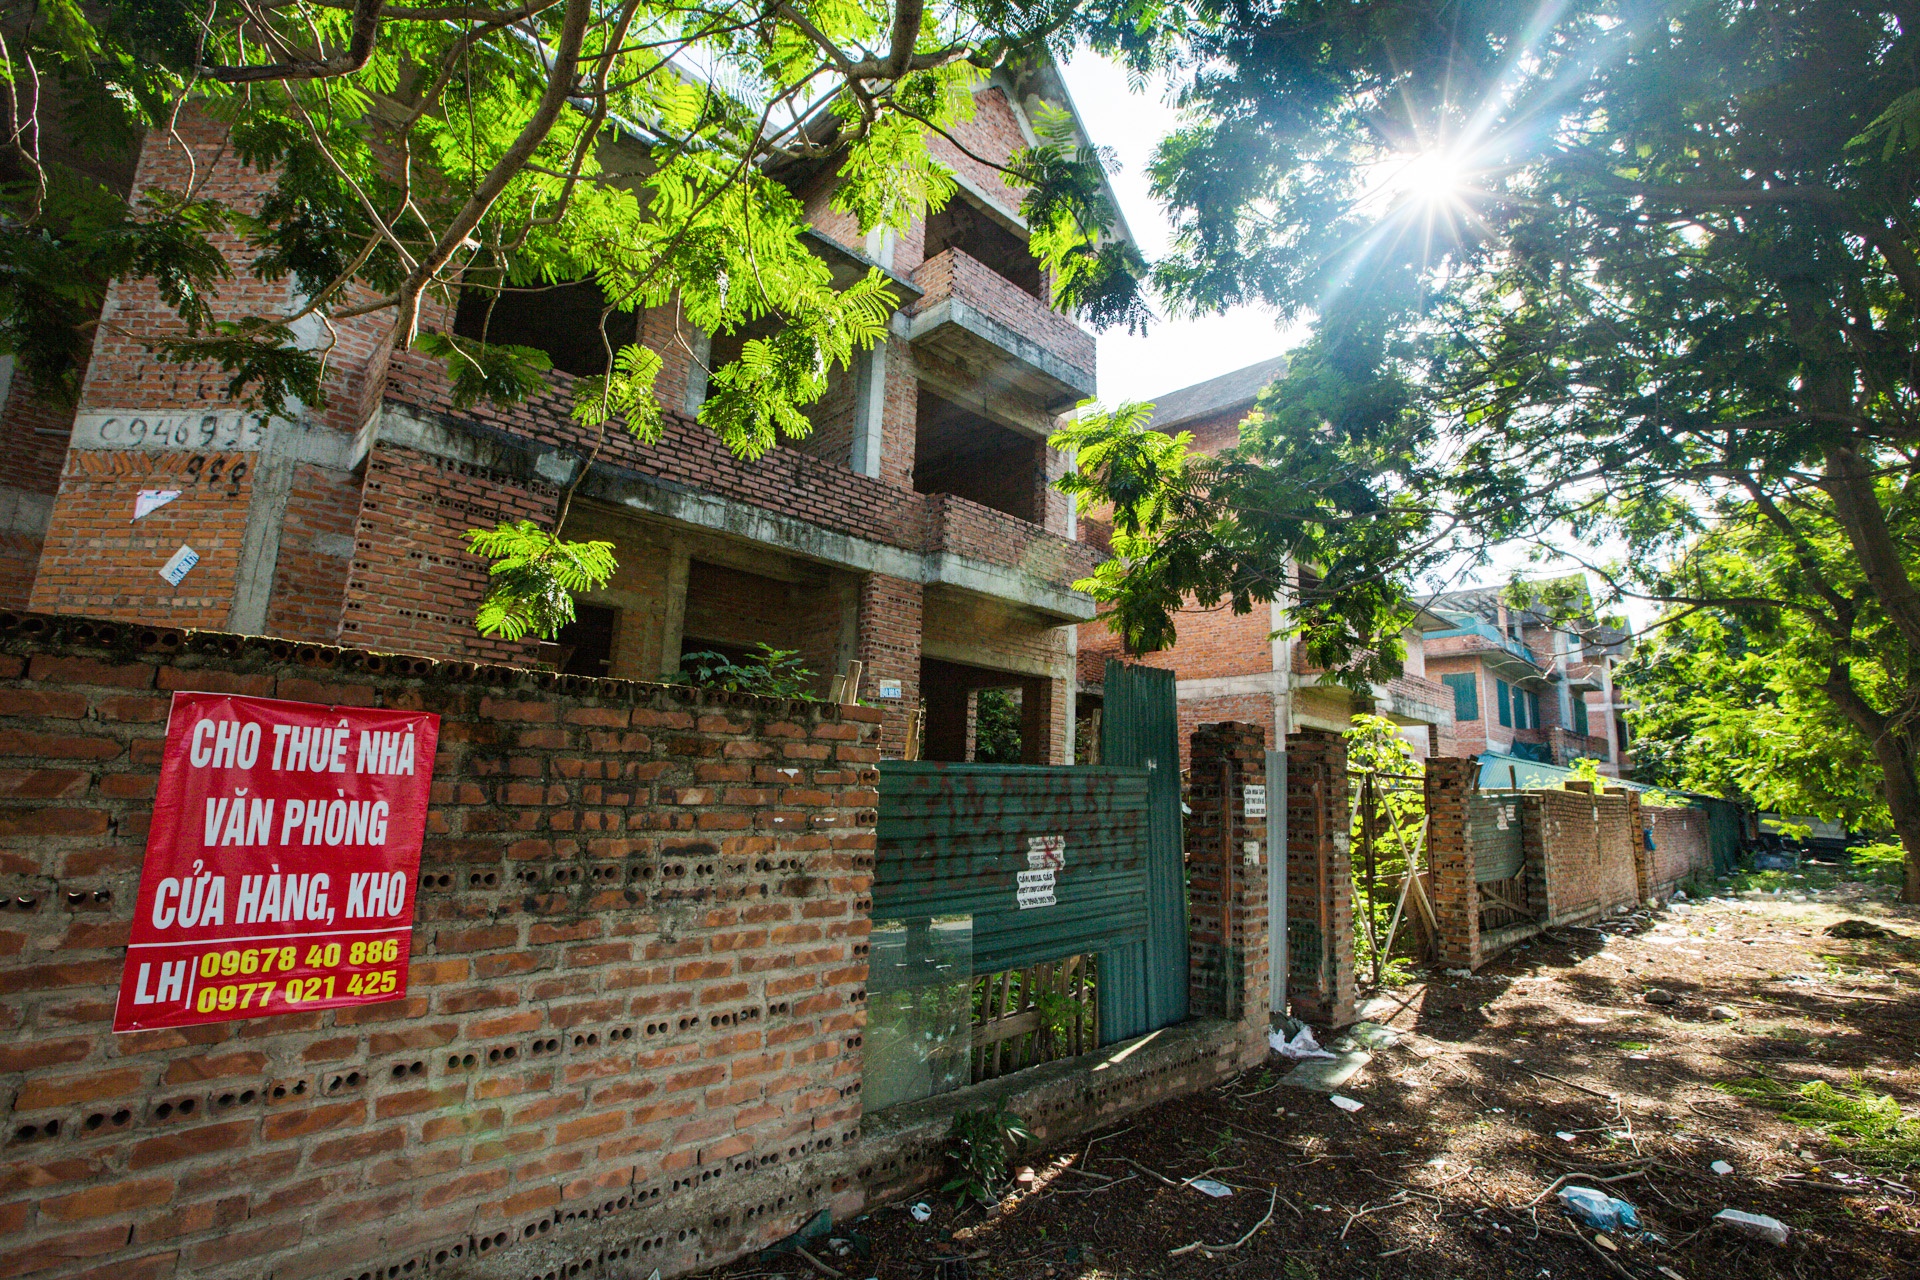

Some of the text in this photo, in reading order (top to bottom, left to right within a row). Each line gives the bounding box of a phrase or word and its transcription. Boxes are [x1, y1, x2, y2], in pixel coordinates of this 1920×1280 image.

[190, 719, 416, 776] CHO THUÊ NHÀ
[204, 788, 390, 847] VĂN PHÒNG
[152, 859, 407, 930] CỬA HÀNG, KHO
[134, 960, 186, 1006] LH
[200, 939, 398, 978] 09678 40 886
[197, 970, 397, 1013] 0977 021 425
